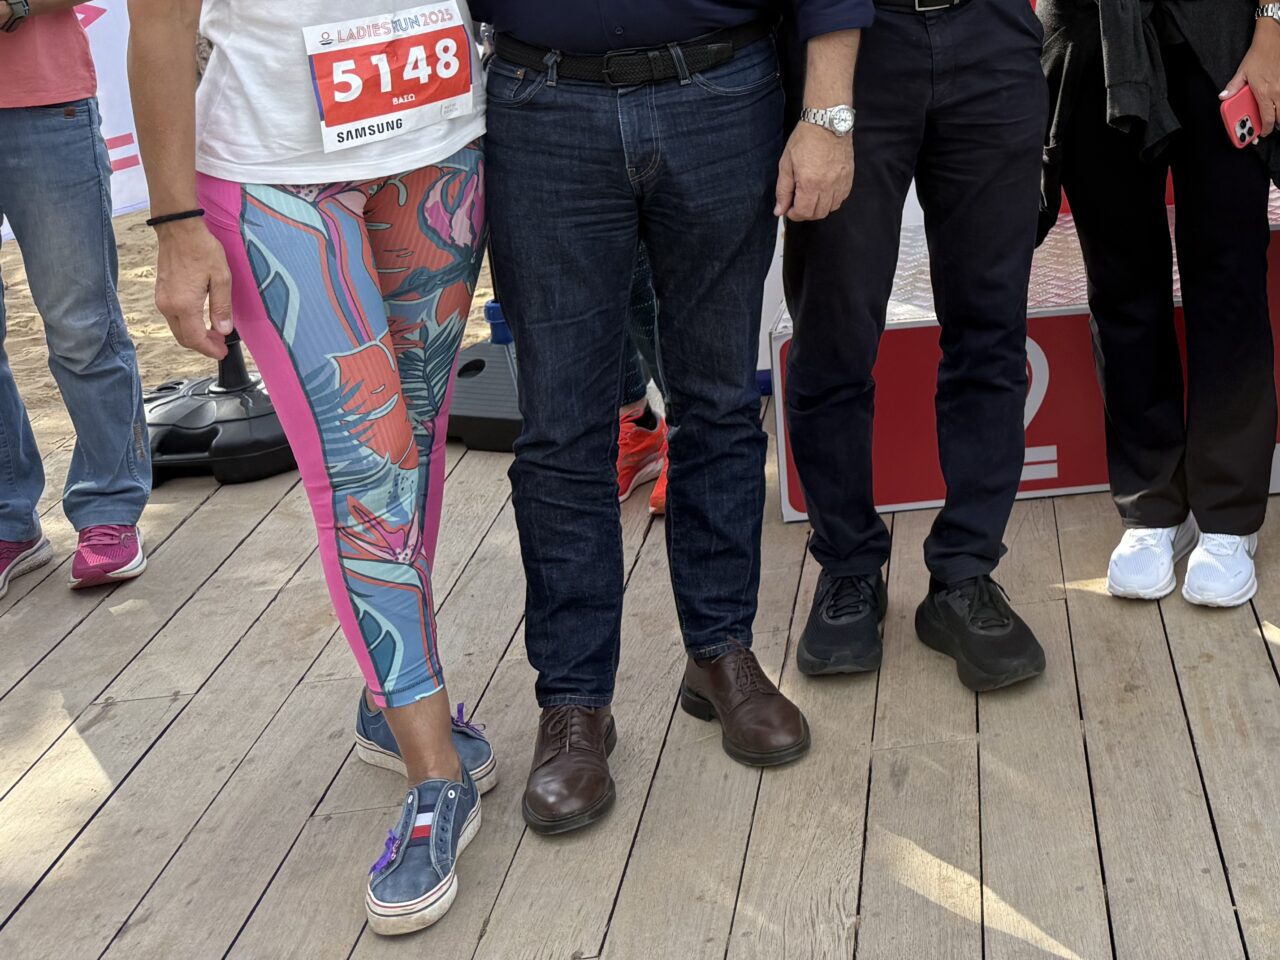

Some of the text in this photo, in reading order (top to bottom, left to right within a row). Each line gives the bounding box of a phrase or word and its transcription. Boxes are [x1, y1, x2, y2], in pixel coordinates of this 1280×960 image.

[337, 20, 392, 43] LADIES
[422, 8, 454, 27] 2025
[331, 38, 460, 103] 5148
[336, 118, 403, 143] SAMSUNG
